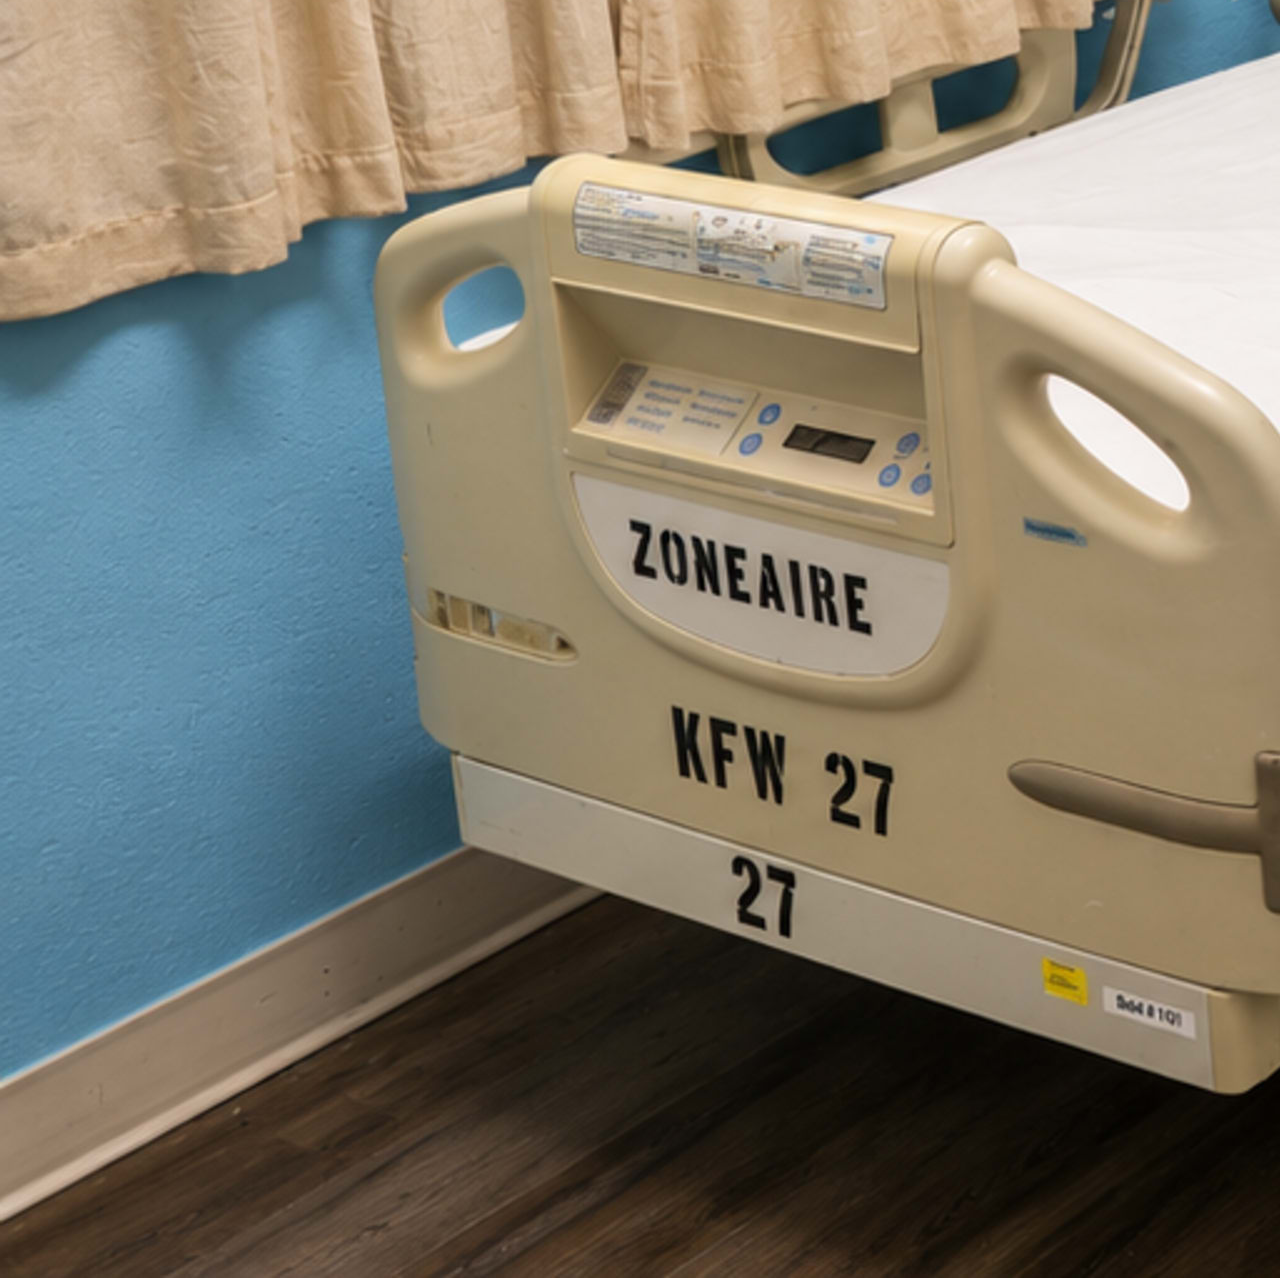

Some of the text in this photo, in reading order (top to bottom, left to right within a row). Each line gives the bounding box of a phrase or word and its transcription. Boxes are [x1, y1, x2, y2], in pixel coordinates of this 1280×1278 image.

[628, 519, 873, 637] ZONEAIRE
[670, 704, 895, 838] KFW 27
[730, 854, 797, 940] 27
